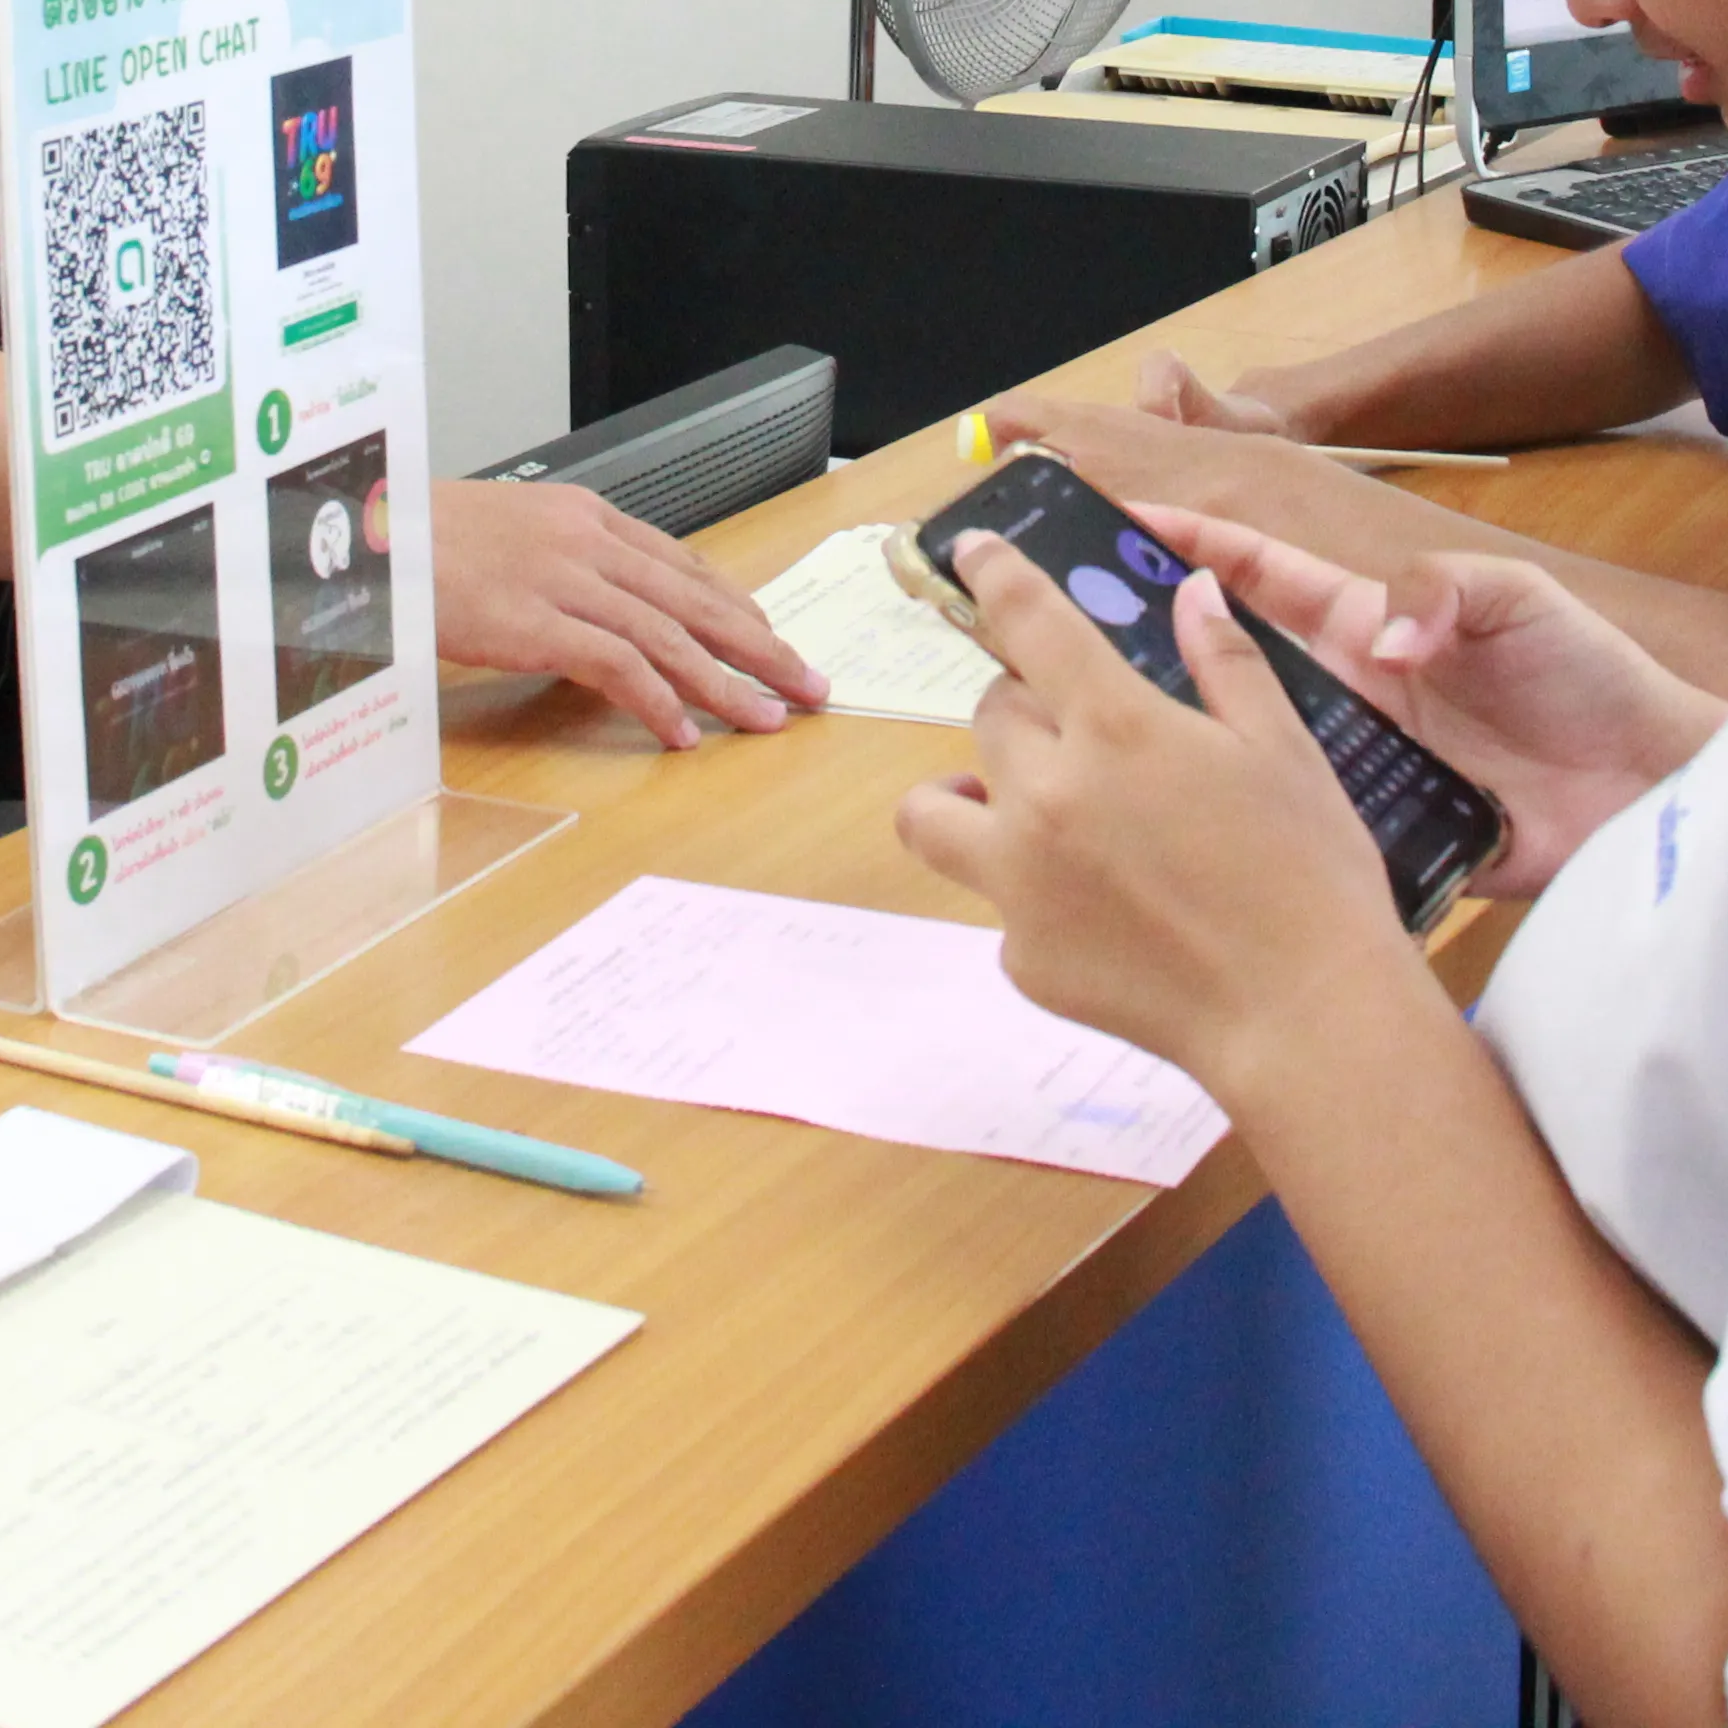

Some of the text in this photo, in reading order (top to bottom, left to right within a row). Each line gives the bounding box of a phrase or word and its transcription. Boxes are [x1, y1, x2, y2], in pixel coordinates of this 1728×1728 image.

[45, 17, 260, 105] LINE OPEN CHAT
[282, 105, 338, 169] TRU
[299, 152, 334, 201] 69
[267, 402, 281, 442] 1
[273, 748, 290, 788] 3
[78, 849, 98, 894] 2
